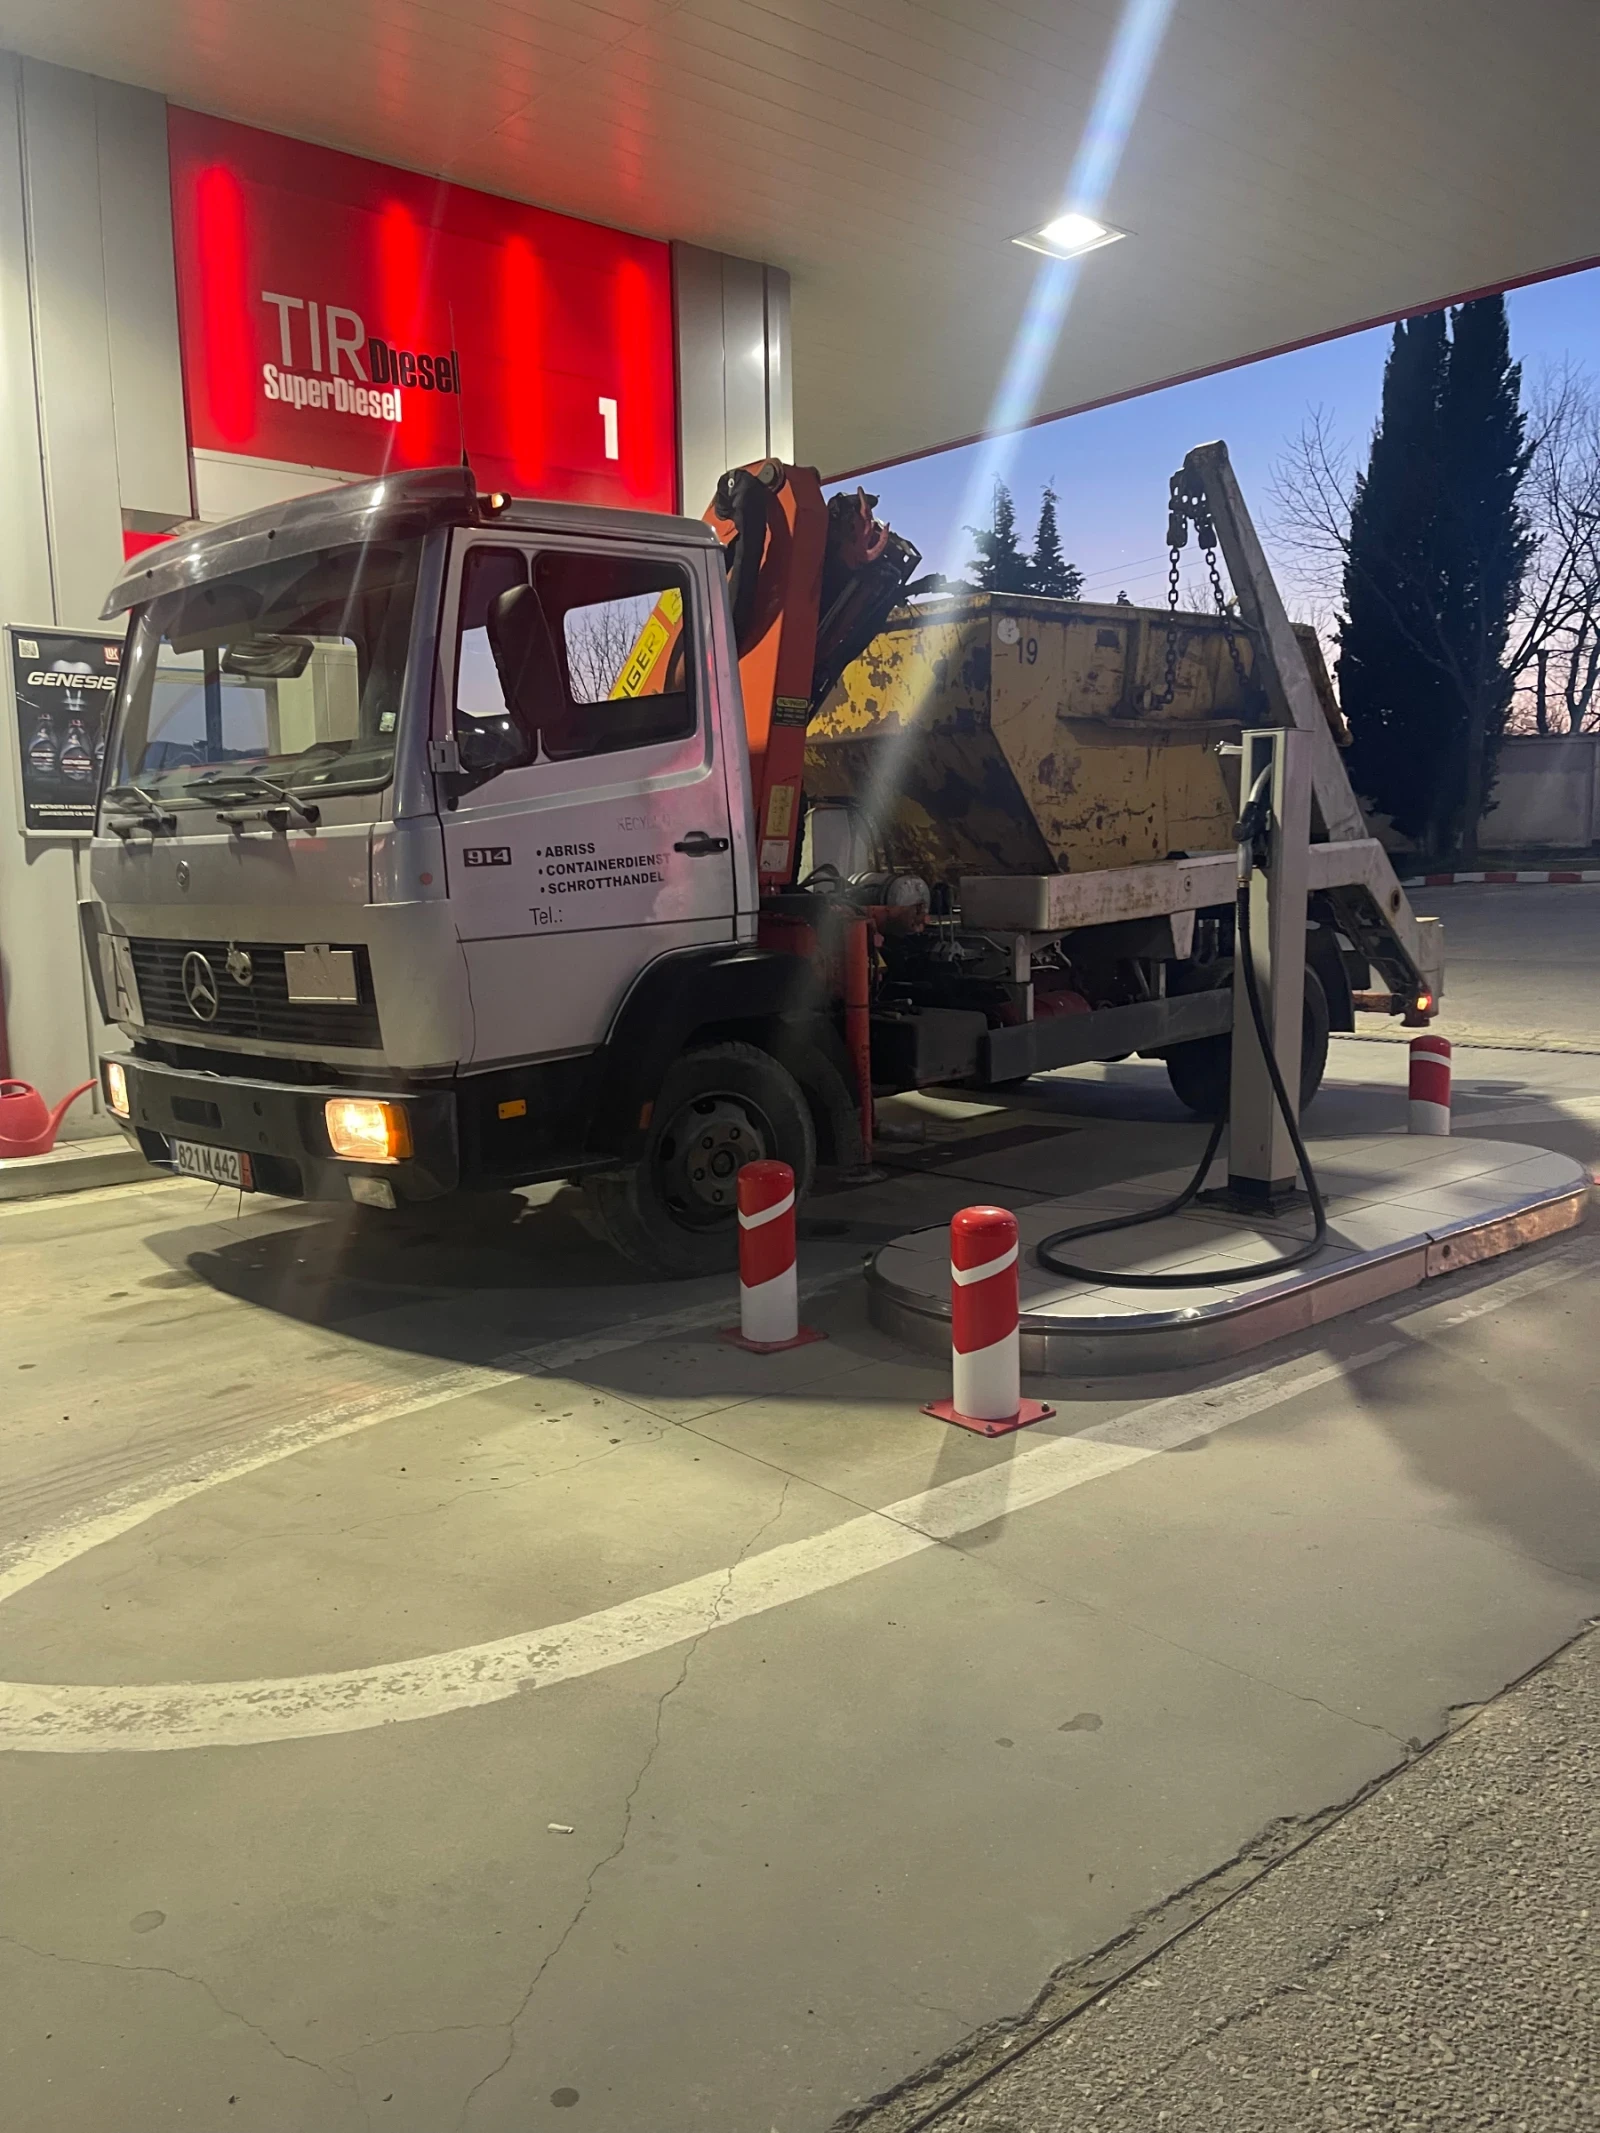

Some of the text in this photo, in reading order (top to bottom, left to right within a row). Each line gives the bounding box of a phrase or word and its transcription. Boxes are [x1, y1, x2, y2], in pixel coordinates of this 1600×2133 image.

[262, 291, 461, 395] TIR Diesel
[263, 363, 402, 423] SuperDiesel
[598, 396, 619, 461] 1
[1016, 637, 1038, 666] 19
[27, 671, 117, 690] GENESIS
[466, 849, 510, 866] 914
[545, 842, 596, 858] ABRISS
[546, 852, 672, 876] CONTAINERDIENST
[548, 871, 665, 894] SCHROTTHANDEL
[528, 906, 564, 926] Tel.:
[178, 1144, 239, 1181] 821M442
